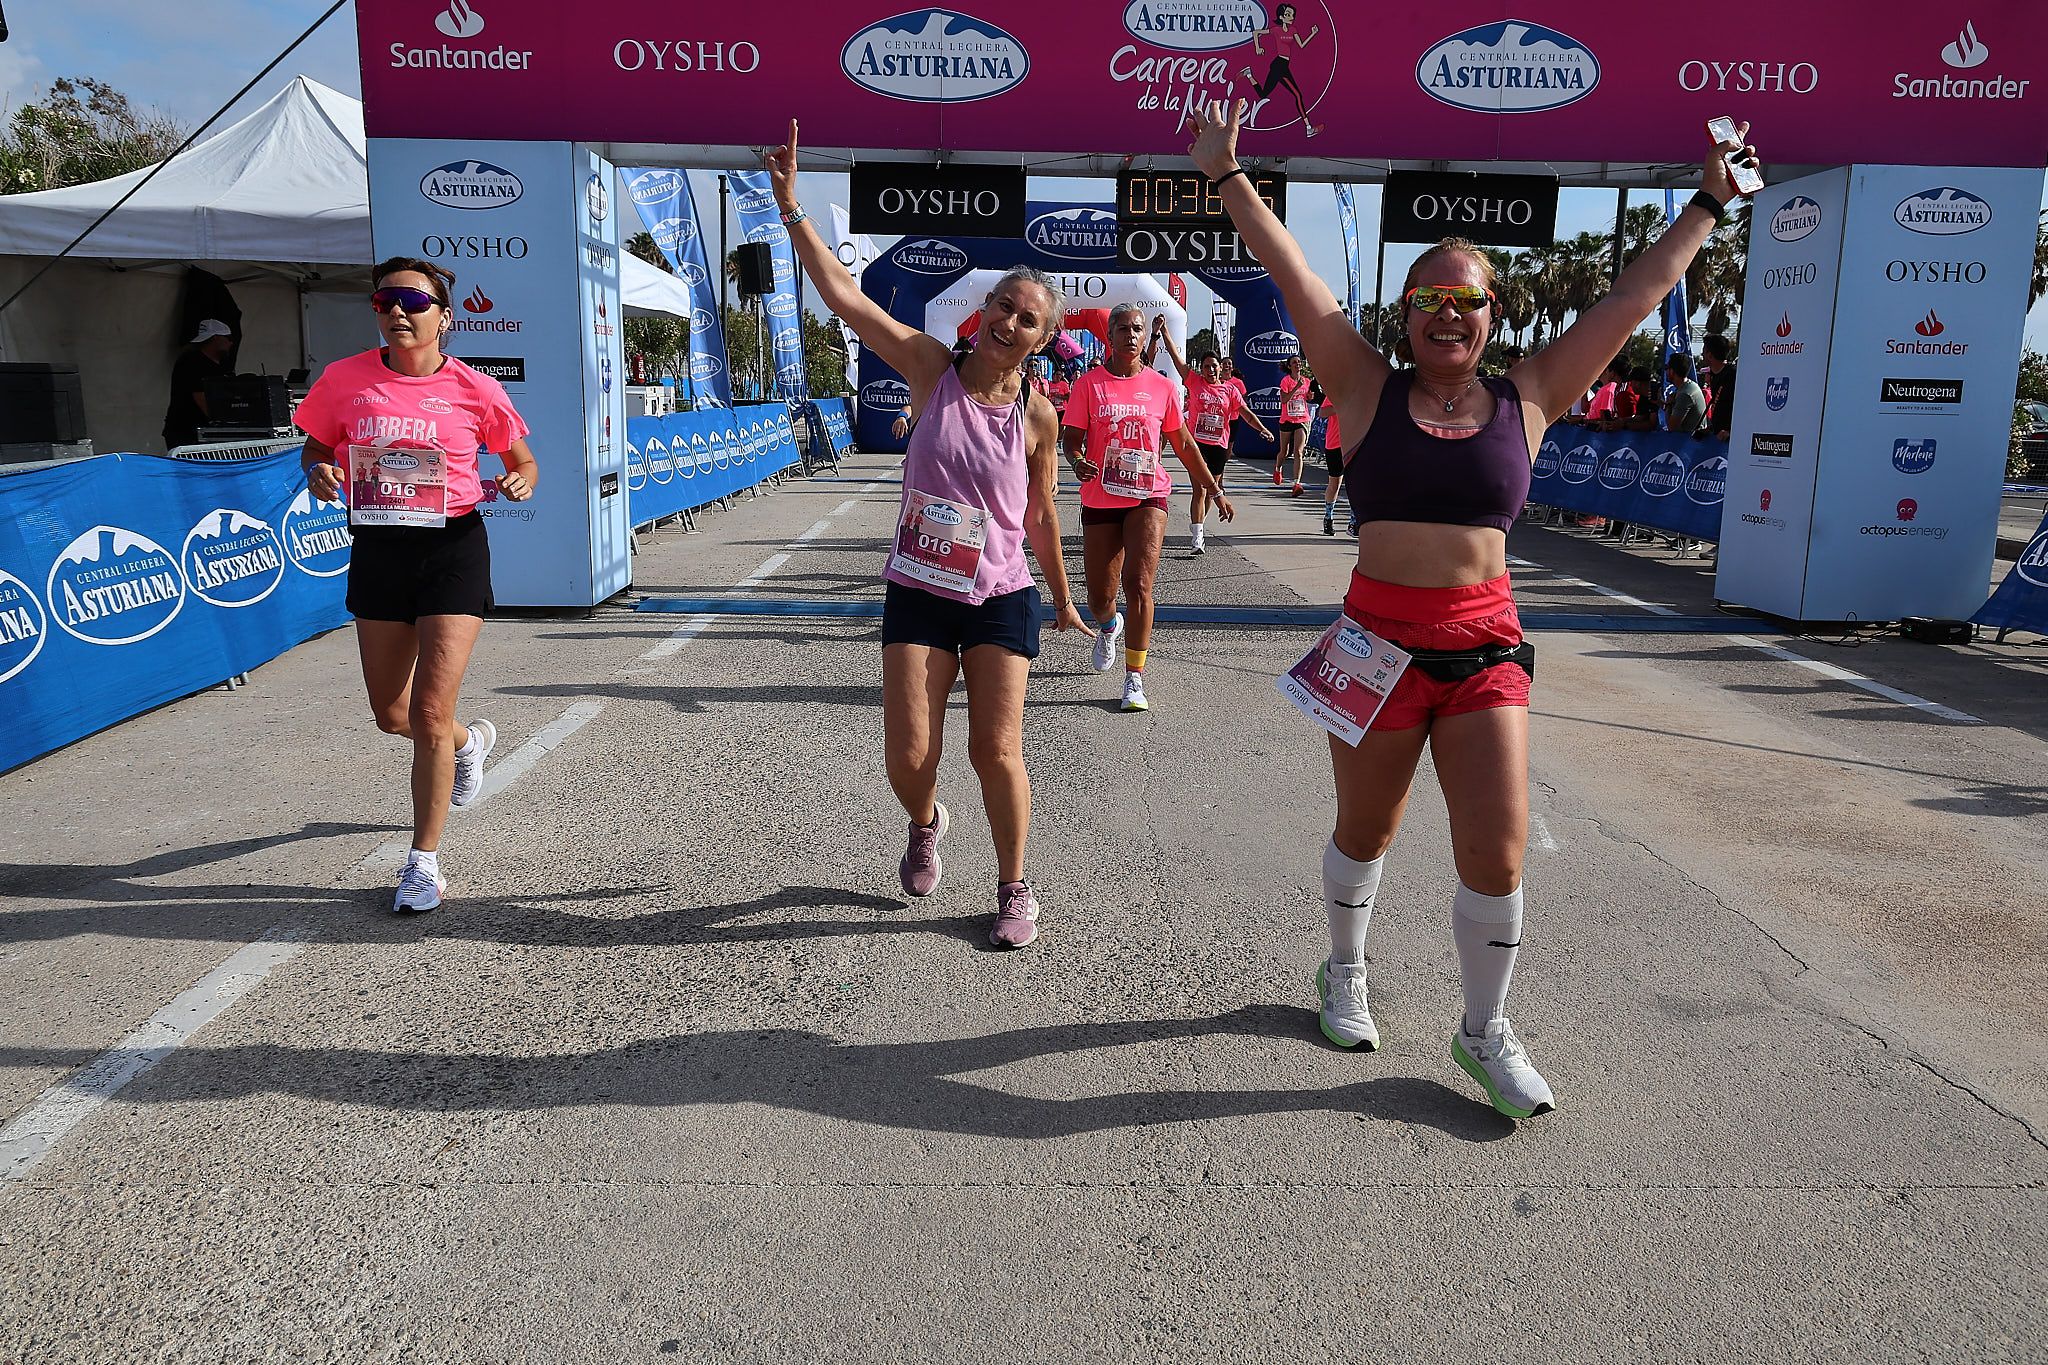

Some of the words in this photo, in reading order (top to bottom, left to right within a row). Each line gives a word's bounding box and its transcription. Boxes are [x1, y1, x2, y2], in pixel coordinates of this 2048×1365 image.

[1156, 2, 1205, 11] CENTRAL
[1208, 3, 1253, 12] LECHERA
[1134, 3, 1256, 34] ASTURIANA
[390, 42, 533, 71] Santander
[613, 39, 761, 73] OYSHO
[884, 40, 943, 51] CENTRAL
[949, 42, 1010, 53] LECHERA
[1459, 51, 1517, 62] CENTRAL
[1523, 53, 1582, 63] LECHERA
[856, 41, 1015, 80] ASTURIANA
[1109, 44, 1227, 84] Carrera
[1430, 53, 1586, 91] ASTURIANA
[1678, 59, 1819, 94] OYSHO
[1892, 73, 2030, 99] Santander
[1137, 85, 1159, 111] de
[1162, 86, 1180, 111] la
[427, 174, 517, 198] ASTURIANA
[879, 187, 1000, 216] OYSHO
[1412, 194, 1533, 226] OYSHO
[1900, 203, 1984, 224] ASTURIANA
[1034, 223, 1117, 247] ASTURIA
[1052, 222, 1091, 230] CENTRAL
[1773, 214, 1817, 235] ASTURIANA
[422, 235, 528, 259] OYSHO
[897, 250, 962, 268] ASTURIANA
[1763, 262, 1817, 290] OYSHO
[1885, 260, 1987, 284] OYSHO
[935, 298, 968, 307] OYSHO
[1136, 300, 1169, 308] OYSHO
[449, 317, 523, 332] antander
[1248, 342, 1298, 354] ASTURIANA
[1760, 340, 1805, 357] Santander
[1885, 339, 1969, 356] Santander
[472, 363, 519, 379] trogena
[353, 396, 389, 406] OYSHO
[863, 389, 911, 405] ASTURIAN
[1887, 383, 1957, 401] Neutrogena
[1098, 403, 1147, 418] CARRERA
[1248, 397, 1281, 411] ASTURI
[356, 415, 437, 440] CARRERA
[1123, 421, 1140, 440] DE
[1754, 437, 1790, 454] Neutrogena
[1894, 446, 1934, 465] Marlene
[381, 458, 417, 467] ASTURIANA
[1119, 470, 1139, 480] 016
[1687, 472, 1726, 494] ASTURIAN
[380, 482, 416, 497] 016
[297, 517, 323, 531] CENTRAL
[360, 513, 389, 521] OYSHO
[925, 507, 960, 524] ASTURIANA
[203, 539, 239, 557] CENTRAL
[290, 524, 354, 561] ASTURIAN
[918, 534, 952, 555] 016
[76, 566, 122, 585] CENTRAL
[125, 556, 166, 575] LECHERA
[193, 544, 281, 592] ASTURIANA
[935, 574, 964, 587] Santander
[62, 571, 180, 625] ASTURIANA
[1339, 634, 1368, 657] STURIANA
[1318, 660, 1351, 692] 016
[1286, 683, 1309, 705] OYSHO
[1319, 711, 1350, 734] Santander
